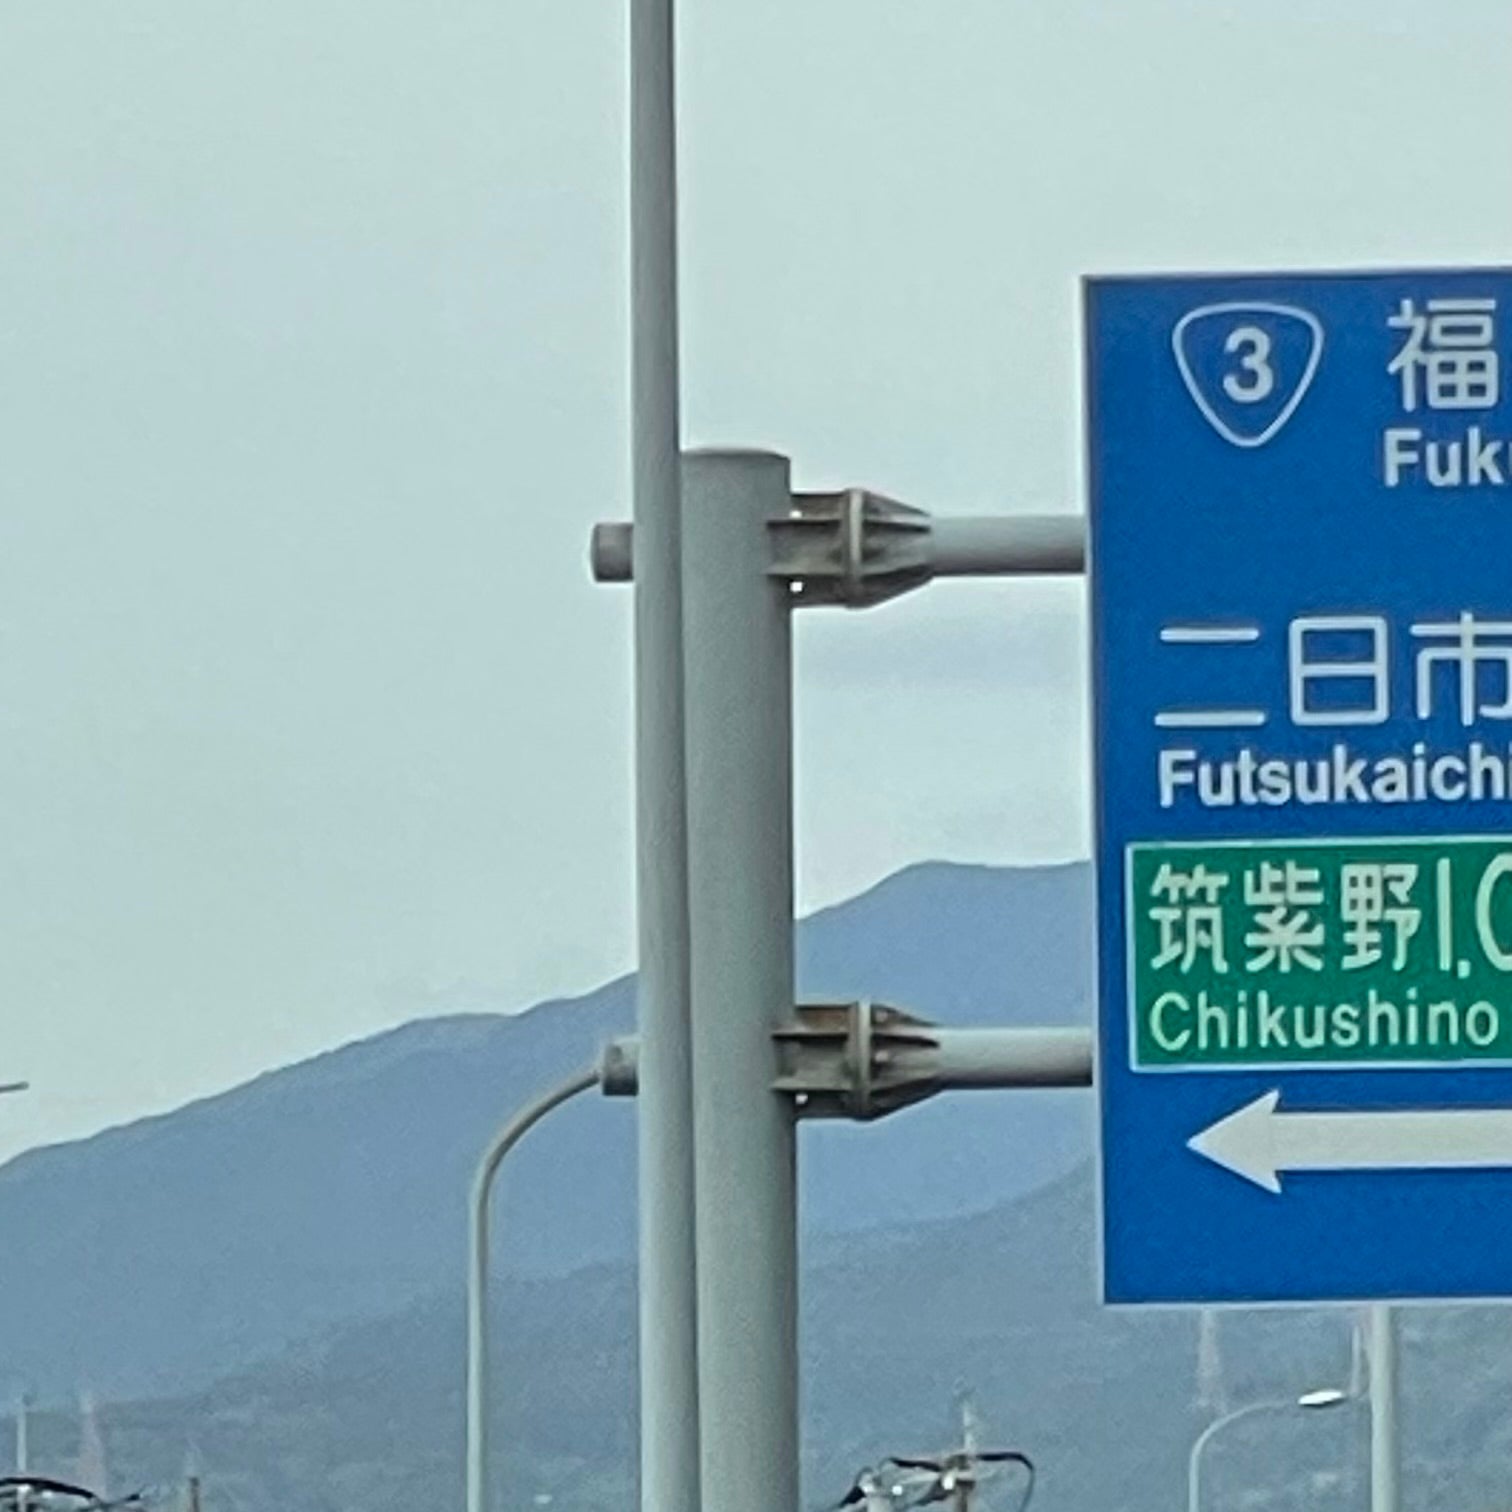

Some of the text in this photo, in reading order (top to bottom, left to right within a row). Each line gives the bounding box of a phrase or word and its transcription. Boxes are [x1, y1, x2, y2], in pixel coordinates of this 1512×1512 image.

[1222, 327, 1274, 403] 3
[1387, 298, 1499, 412] 福
[1384, 427, 1512, 487] Fuk
[1154, 612, 1512, 727] 二日市
[1149, 987, 1499, 1051] Chikushino
